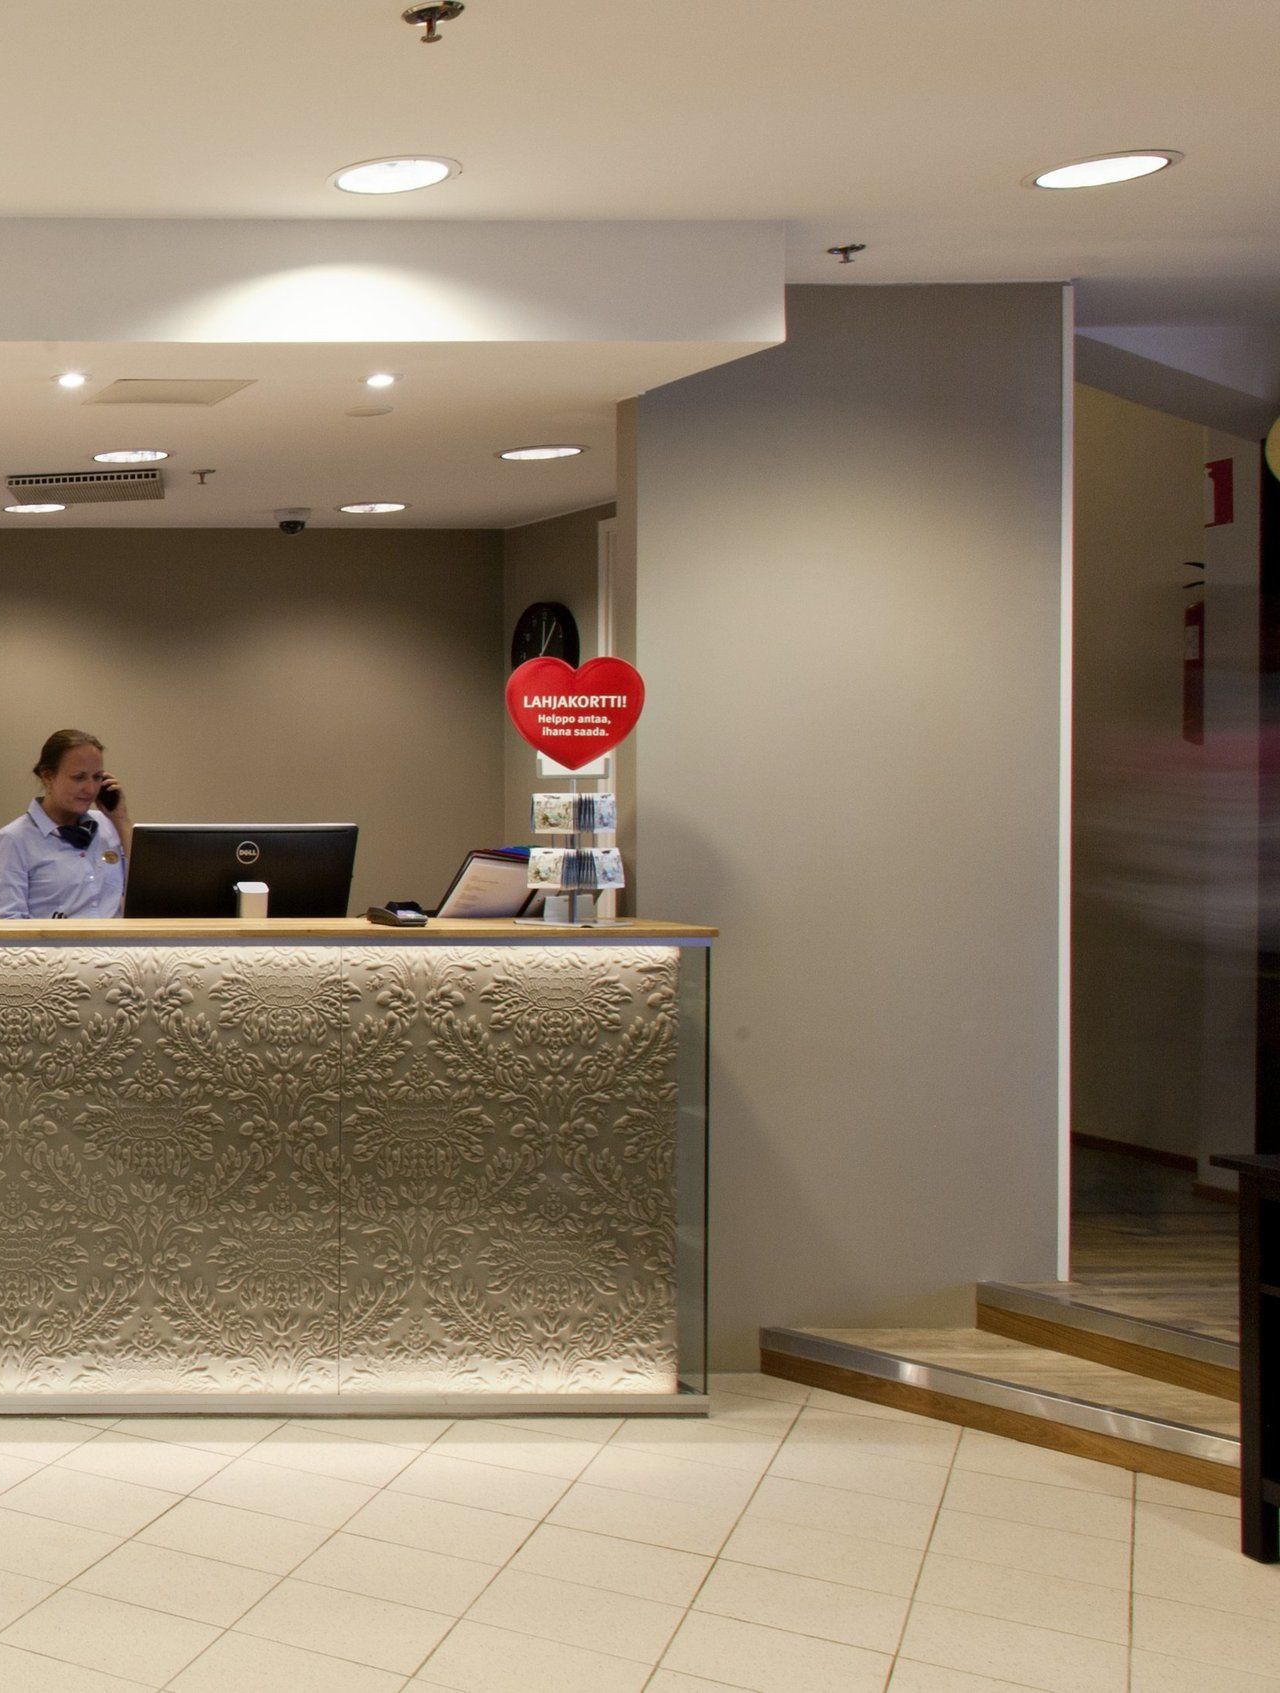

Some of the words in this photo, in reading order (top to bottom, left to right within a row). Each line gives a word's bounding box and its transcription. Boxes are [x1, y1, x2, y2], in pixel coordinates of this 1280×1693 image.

[523, 695, 628, 710] LAHJAKORTTI!
[537, 714, 576, 725] Helppo
[577, 714, 612, 725] antaa,
[542, 727, 572, 737] ihana
[573, 727, 609, 737] saada.
